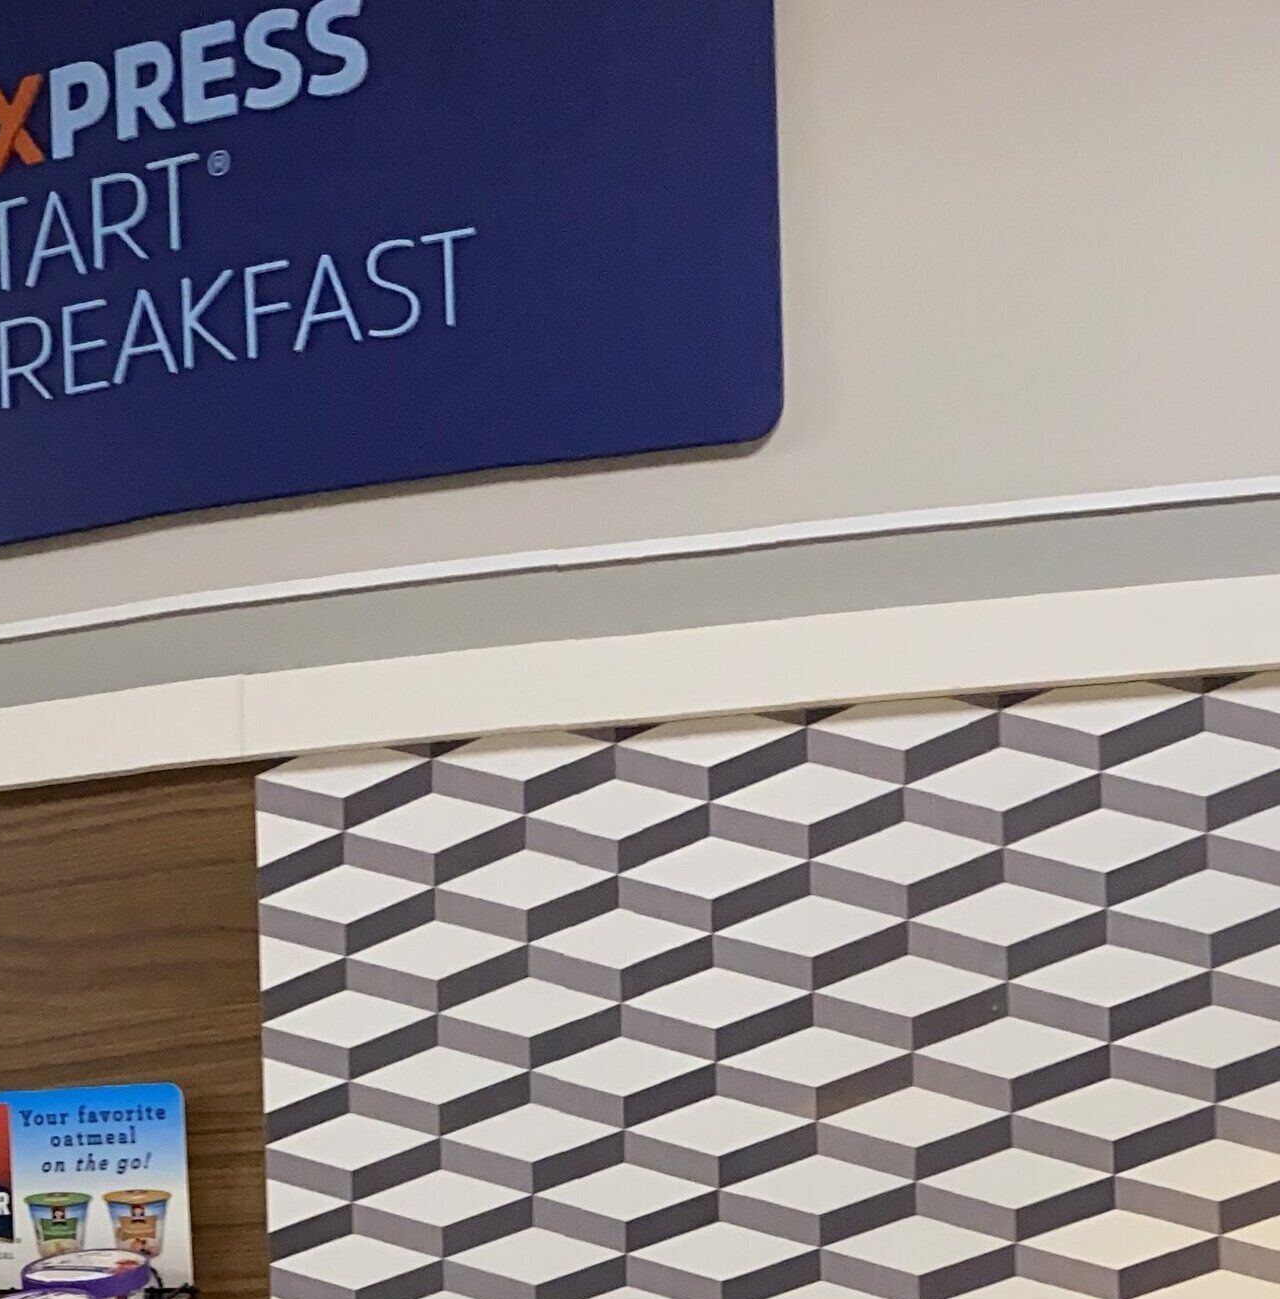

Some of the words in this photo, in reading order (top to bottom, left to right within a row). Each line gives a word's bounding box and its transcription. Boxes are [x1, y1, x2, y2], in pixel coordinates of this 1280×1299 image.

[18, 1108, 68, 1128] Your
[77, 1104, 167, 1124] favorite
[50, 1126, 137, 1148] oatmeal
[41, 1160, 66, 1173] on
[75, 1152, 109, 1172] the
[116, 1152, 152, 1174] go!
